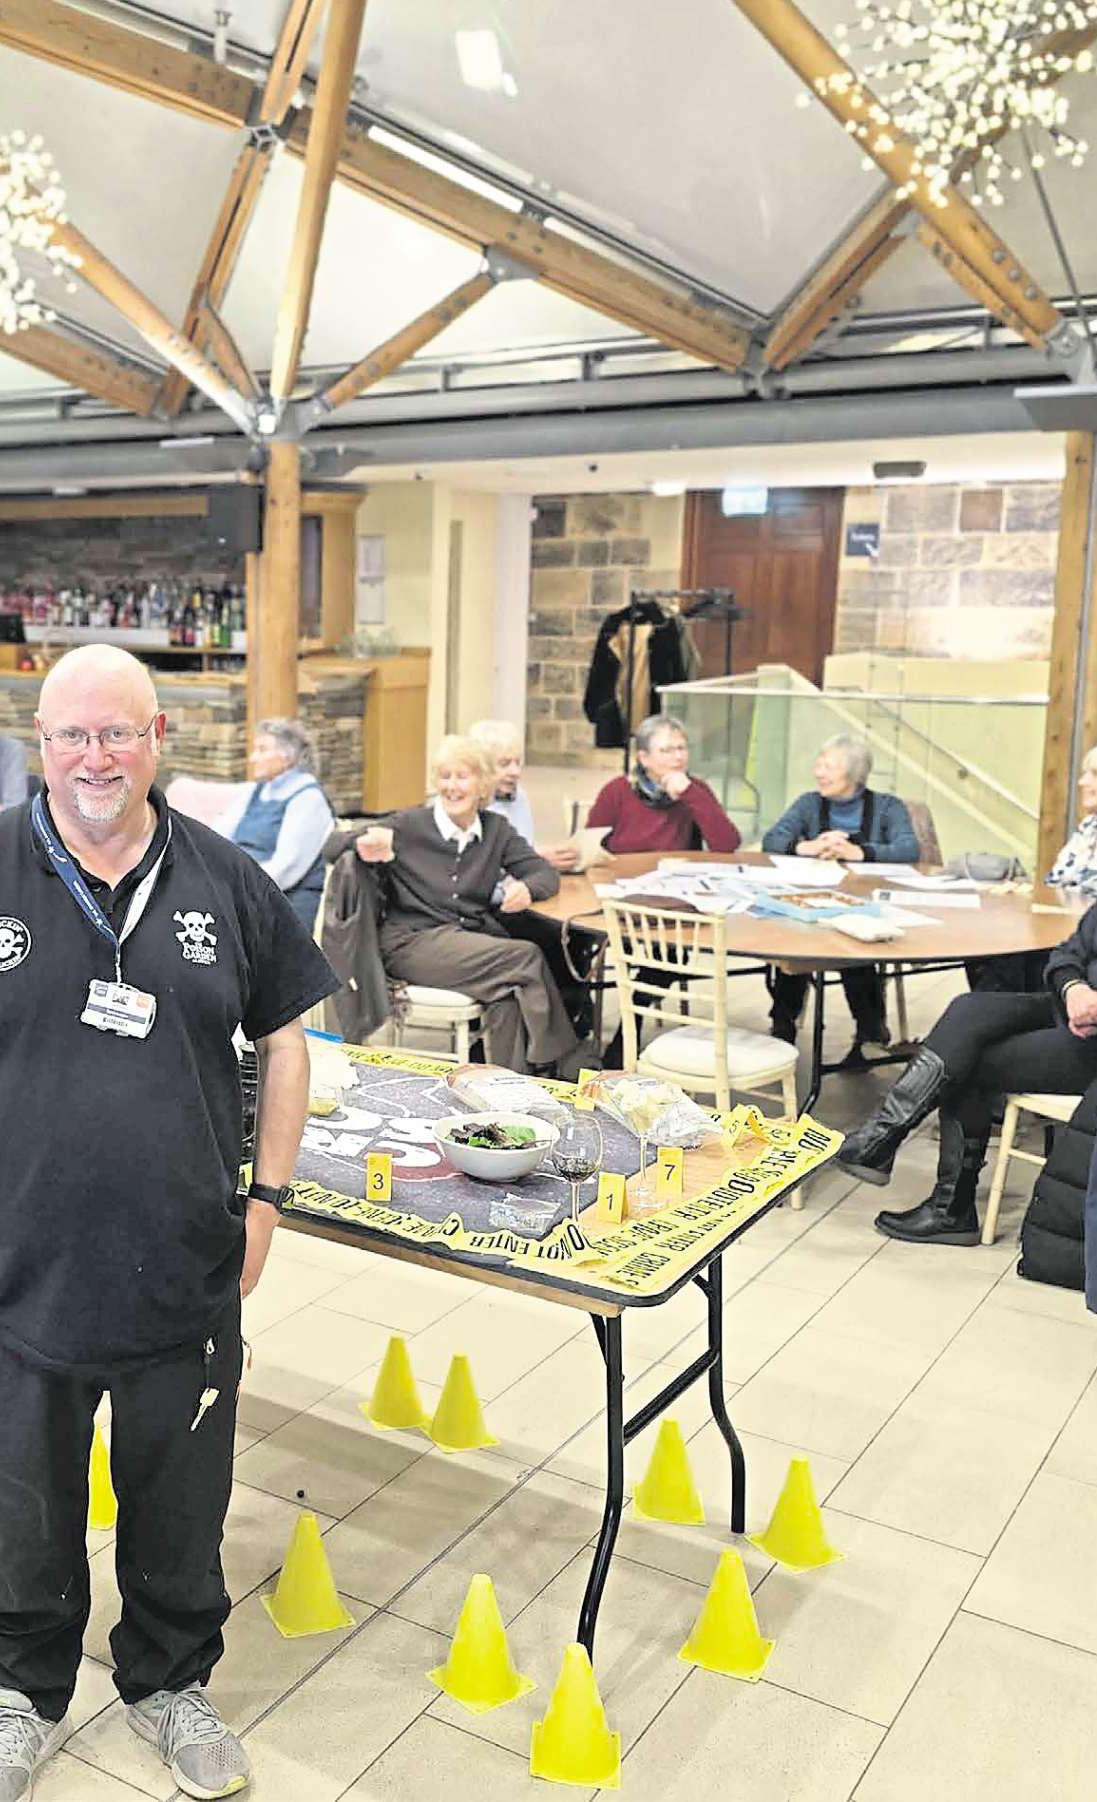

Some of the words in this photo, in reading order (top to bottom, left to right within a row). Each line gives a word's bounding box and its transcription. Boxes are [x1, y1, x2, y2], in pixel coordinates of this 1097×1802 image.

[372, 1172, 385, 1190] 3
[664, 1163, 676, 1181] 7
[606, 1193, 614, 1211] 1
[469, 1233, 530, 1254] ENTER
[536, 1233, 573, 1261] NOT
